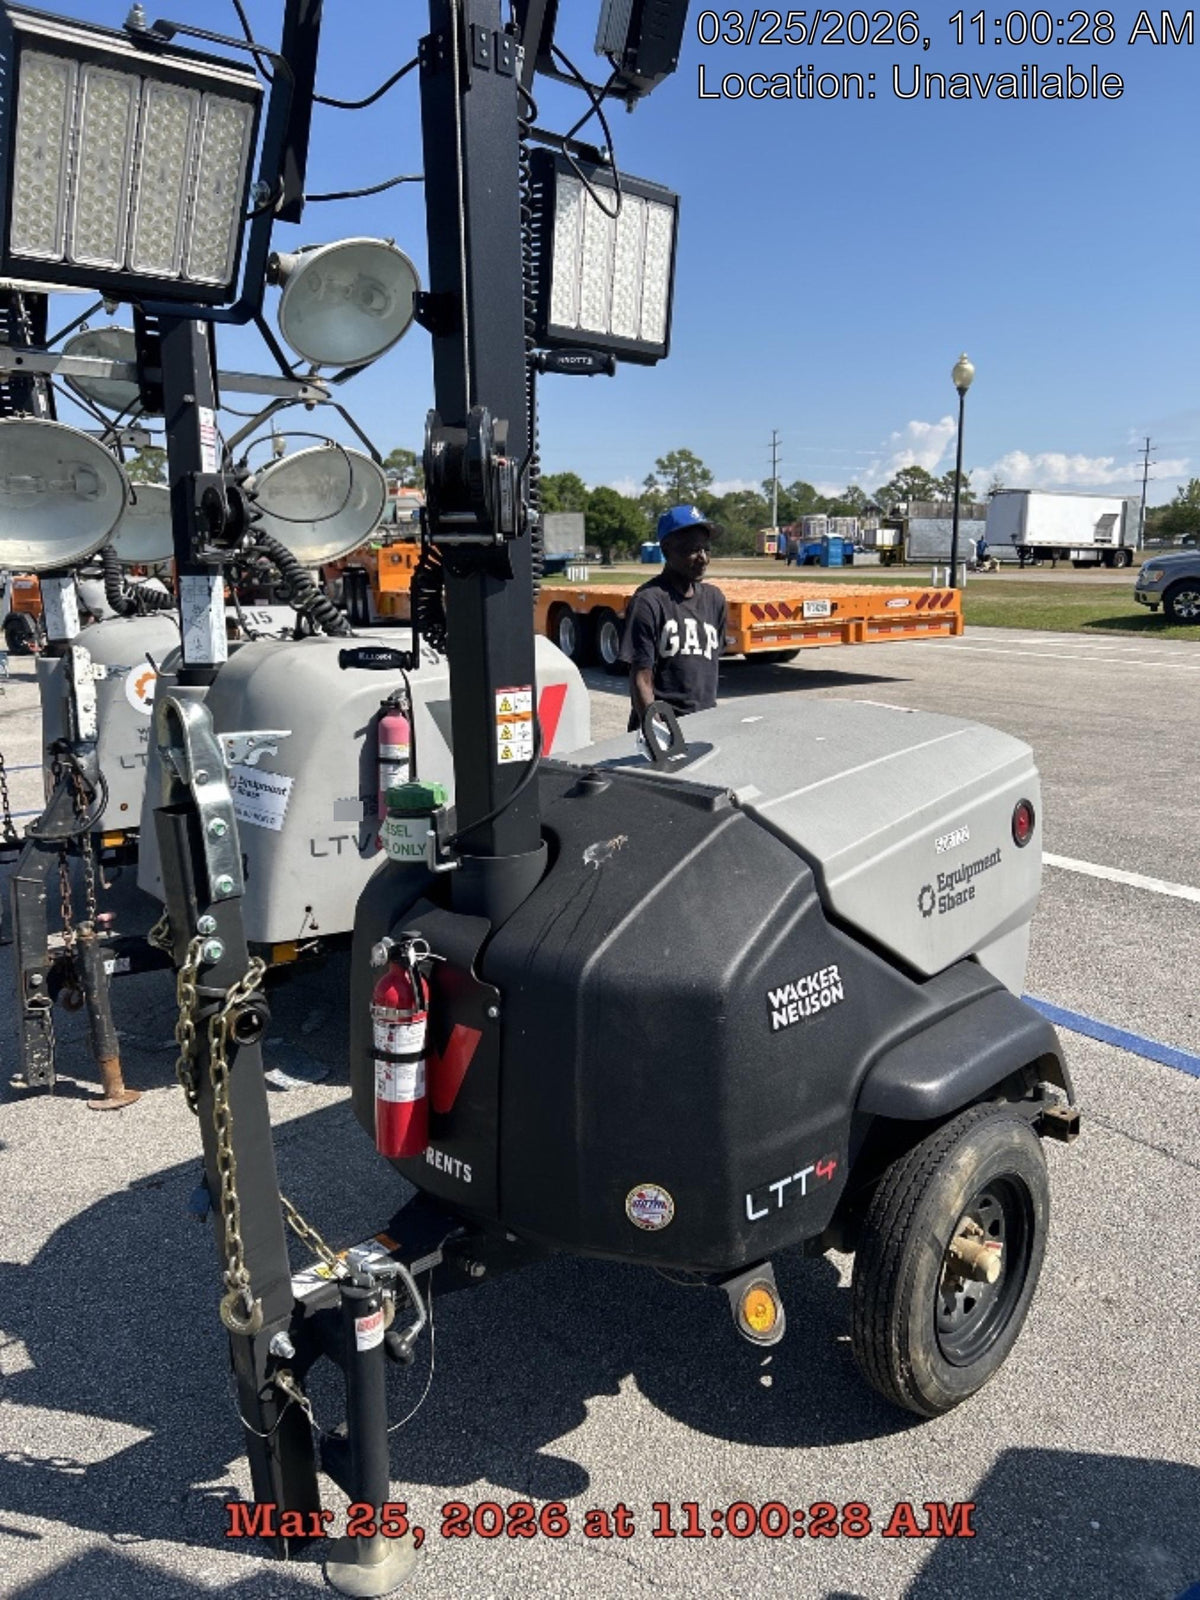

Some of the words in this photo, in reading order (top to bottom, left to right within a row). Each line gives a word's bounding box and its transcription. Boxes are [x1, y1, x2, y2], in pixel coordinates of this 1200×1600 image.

[660, 618, 719, 660] GAP
[392, 841, 427, 857] ONLY
[937, 847, 1002, 893] Equipment
[938, 885, 976, 914] Share
[767, 964, 842, 1009] WACKER
[771, 981, 845, 1031] NEUSON
[423, 1146, 472, 1184] RENTS
[746, 1159, 837, 1221] LTT4
